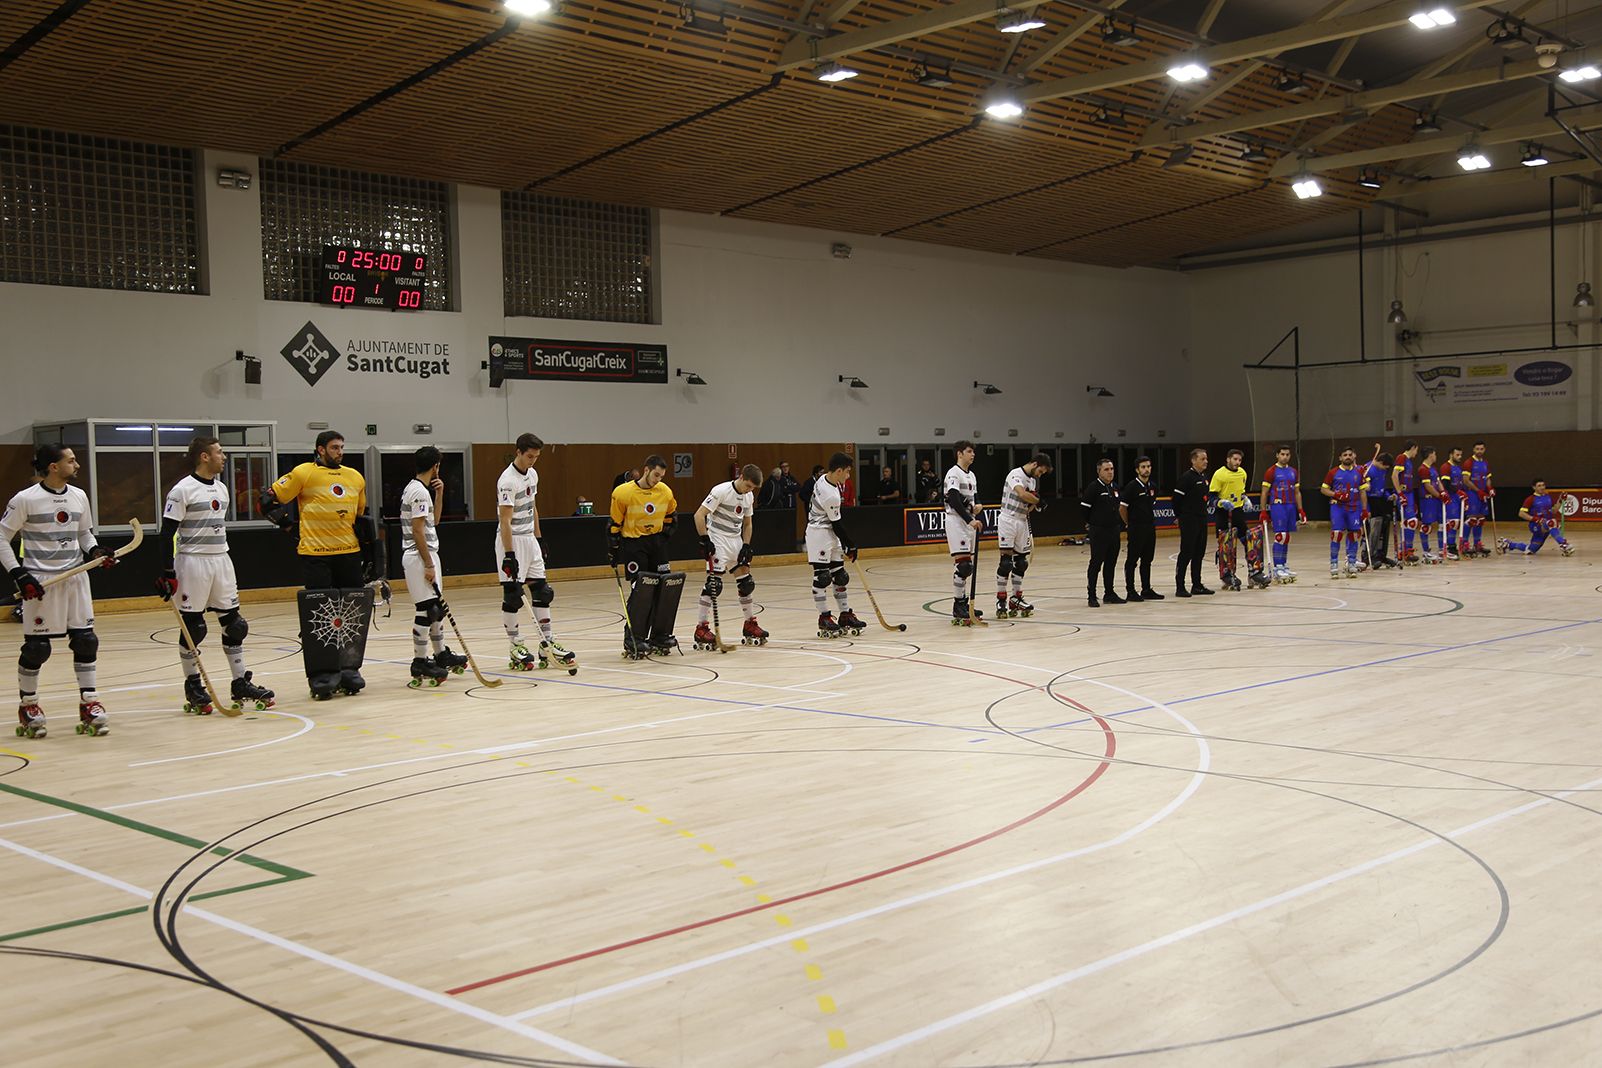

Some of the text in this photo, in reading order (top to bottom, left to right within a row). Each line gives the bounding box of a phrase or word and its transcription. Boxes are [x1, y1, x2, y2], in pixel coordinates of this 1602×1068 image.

[337, 250, 424, 271] 0 25:00 0
[328, 271, 356, 282] LOCAL
[394, 276, 421, 287] VISITANT
[332, 285, 421, 308] 00 00
[346, 339, 449, 356] AJUNTAMENT DE
[346, 353, 450, 379] SantCugat
[534, 349, 627, 372] SantCugatCreix
